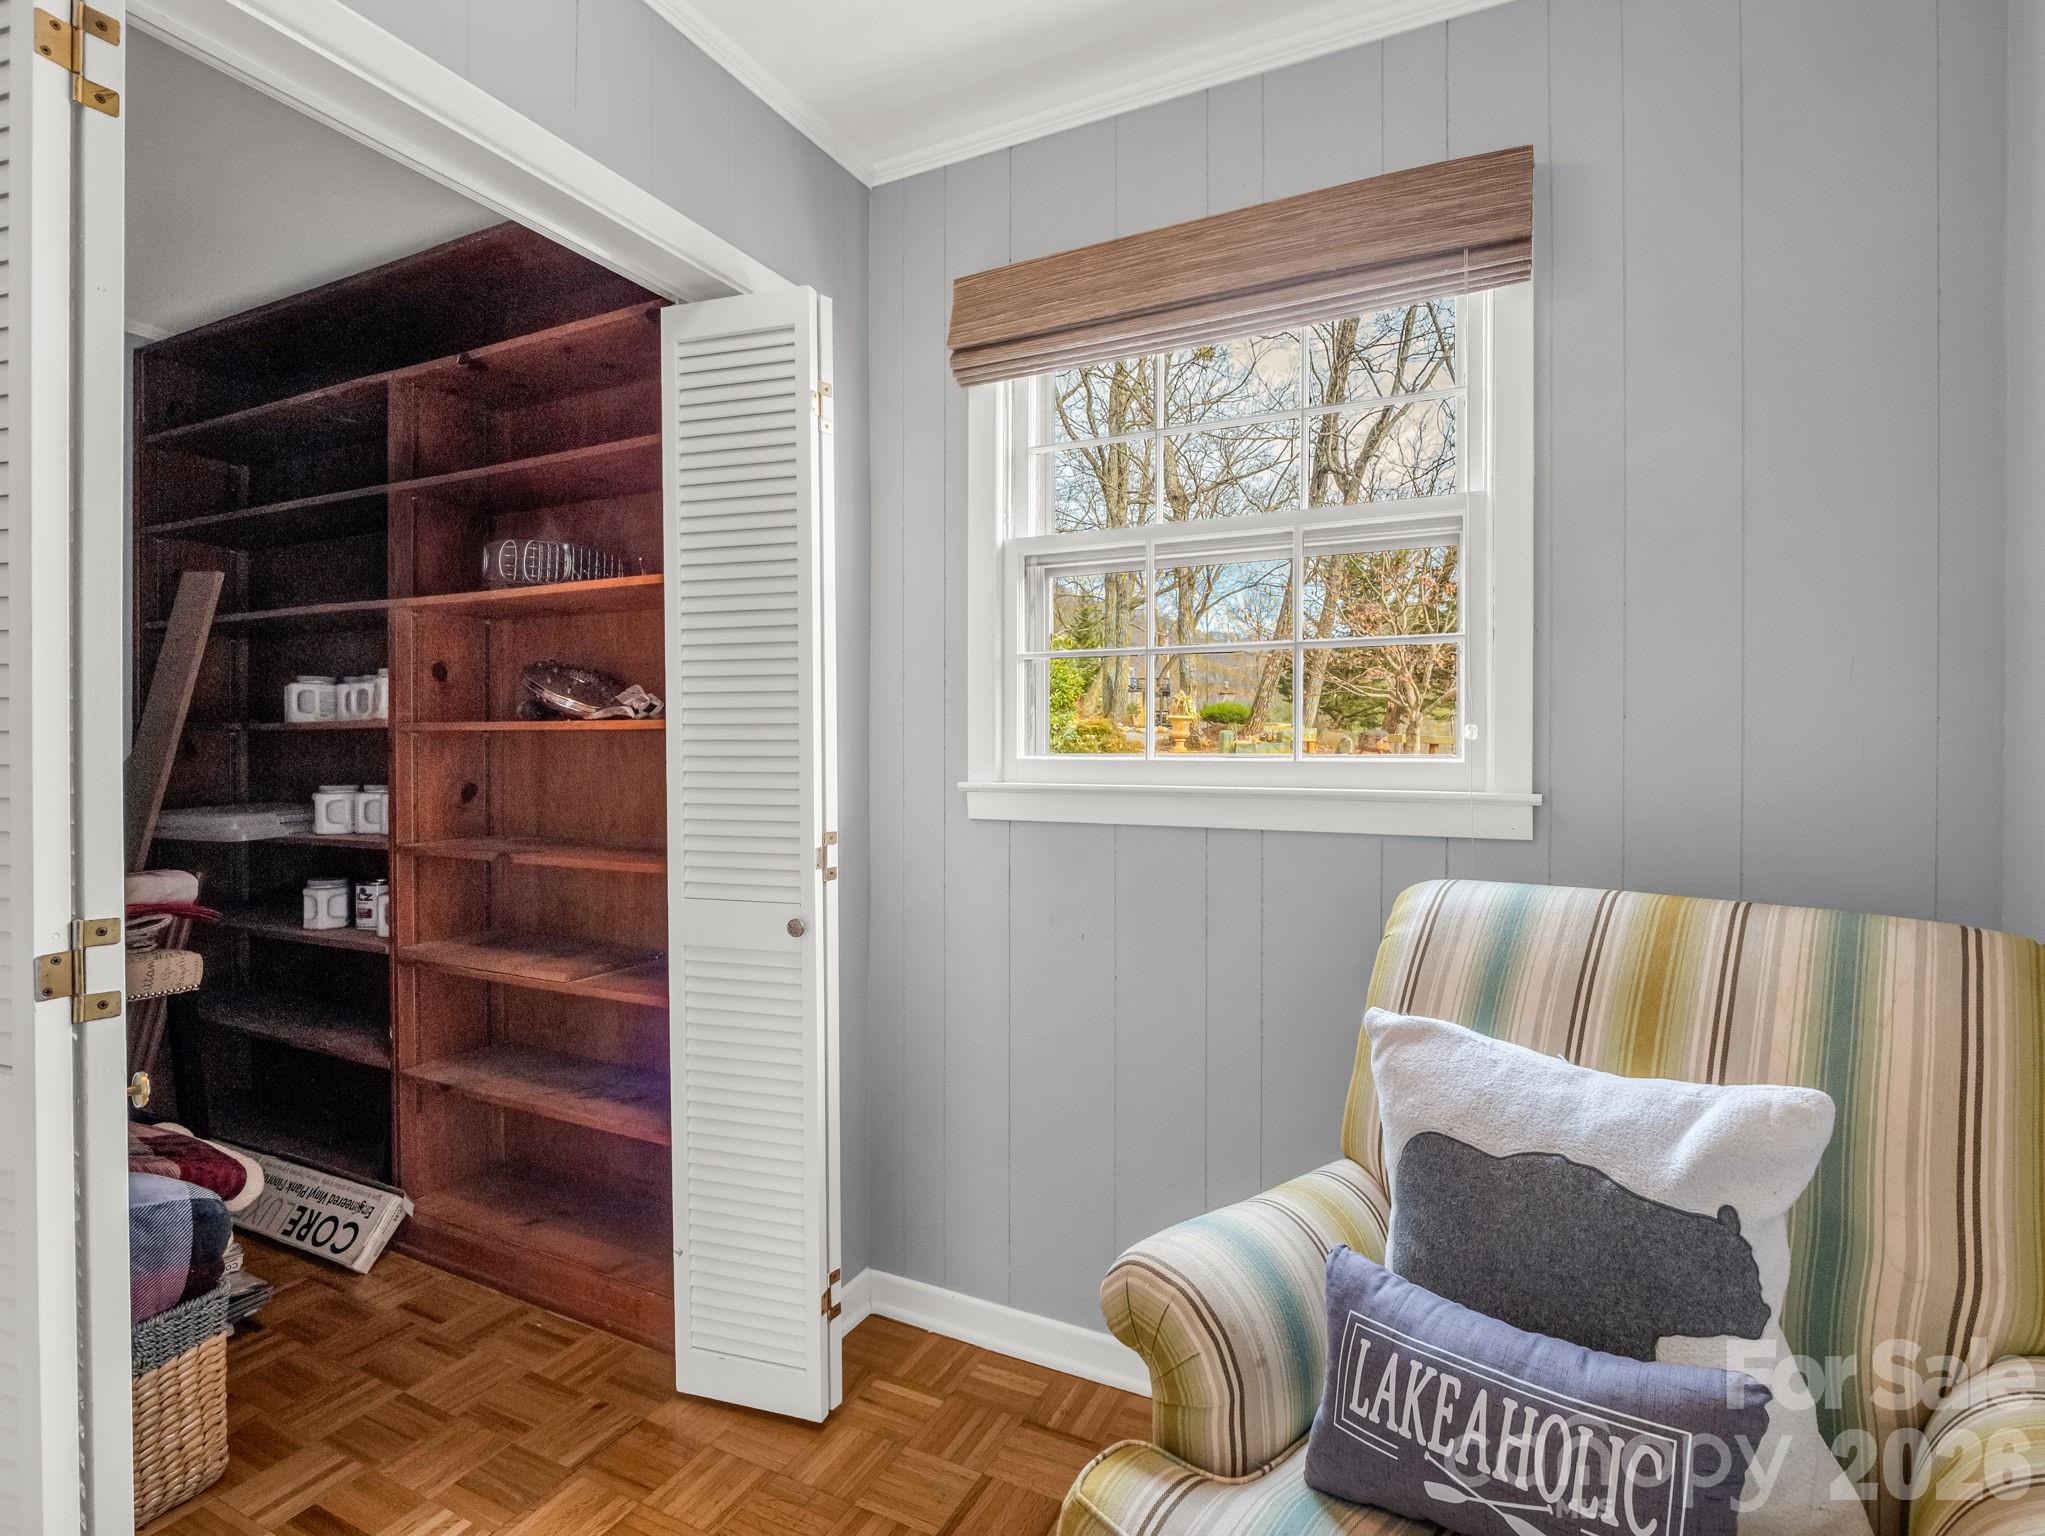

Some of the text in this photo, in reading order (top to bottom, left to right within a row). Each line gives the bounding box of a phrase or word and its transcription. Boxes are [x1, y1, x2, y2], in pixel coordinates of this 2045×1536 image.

[263, 1169, 288, 1191] Floorin
[286, 1180, 309, 1198] Plank
[306, 1185, 326, 1205] Vinyl
[327, 1194, 375, 1219] Engineered
[1349, 1338, 1663, 1534] LAKEAHOLIC
